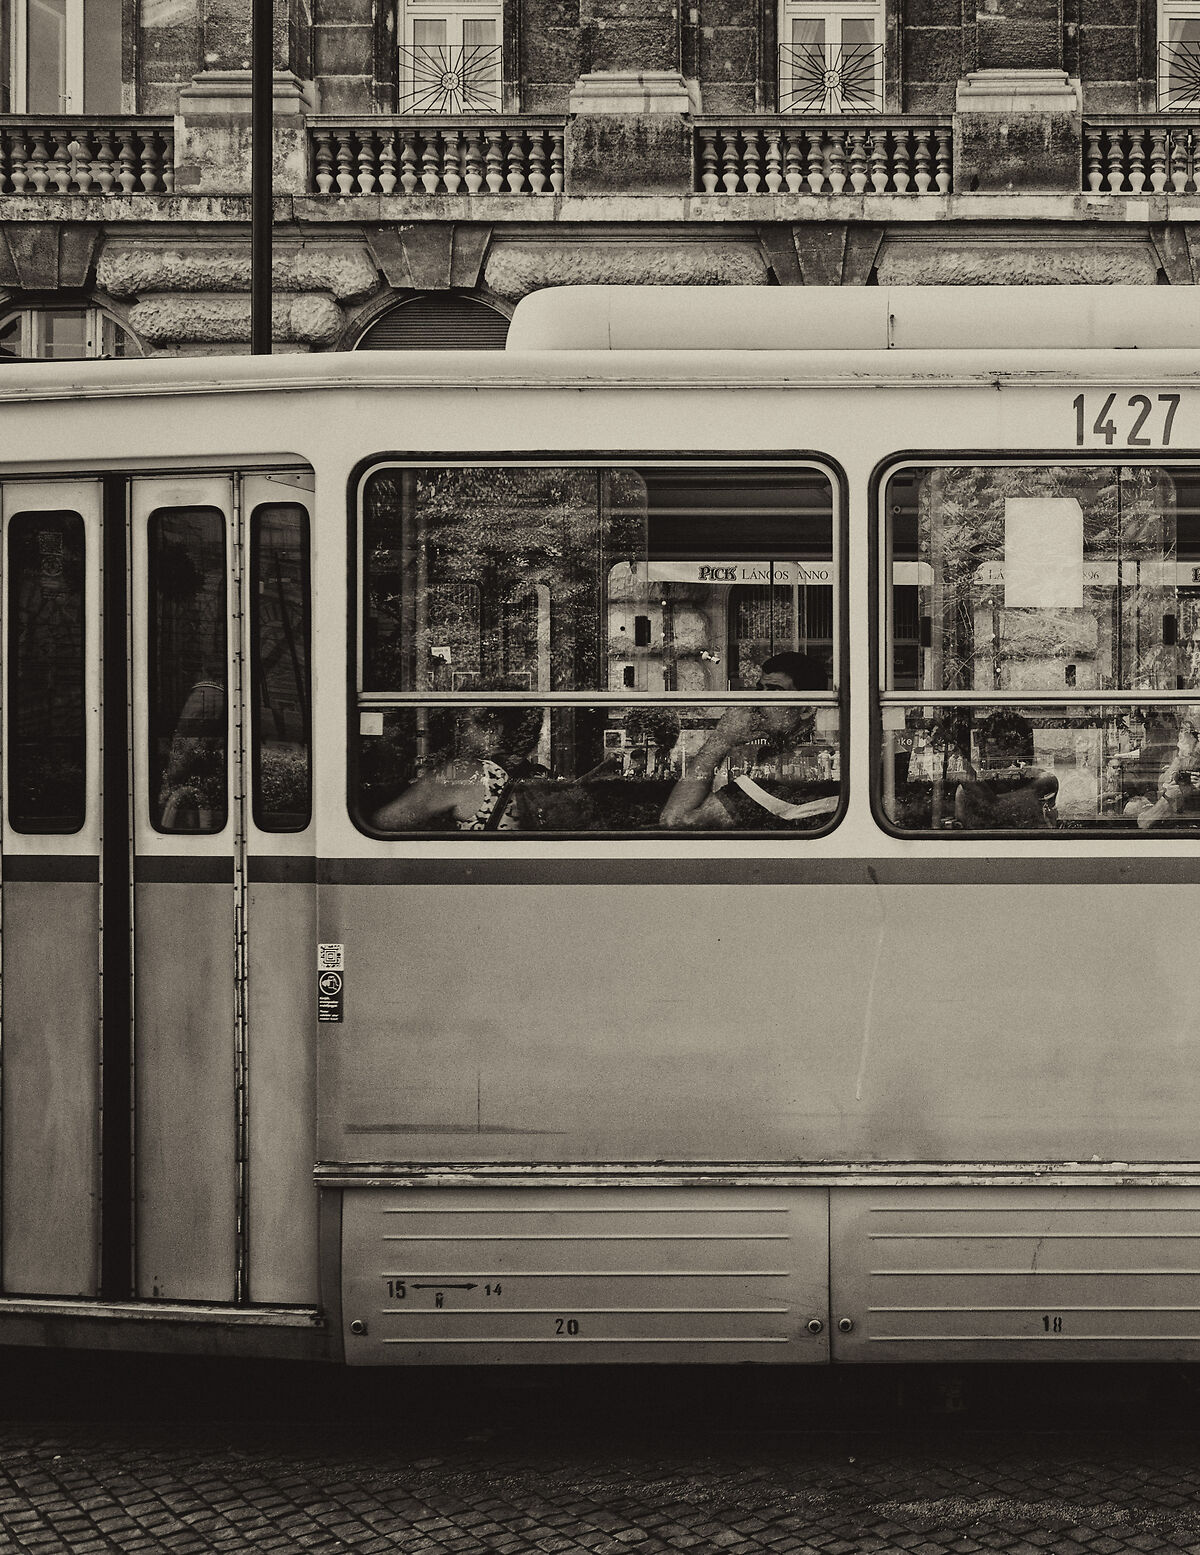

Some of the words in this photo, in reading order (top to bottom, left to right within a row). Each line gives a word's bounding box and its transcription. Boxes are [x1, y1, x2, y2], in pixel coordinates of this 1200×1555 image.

[1073, 393, 1181, 446] 1427
[698, 565, 738, 581] PICK
[797, 570, 829, 580] ANNO
[1082, 570, 1100, 581] 896
[386, 1280, 406, 1299] 15
[484, 1283, 502, 1296] 14
[555, 1318, 579, 1335] 20
[1042, 1315, 1062, 1332] 18
